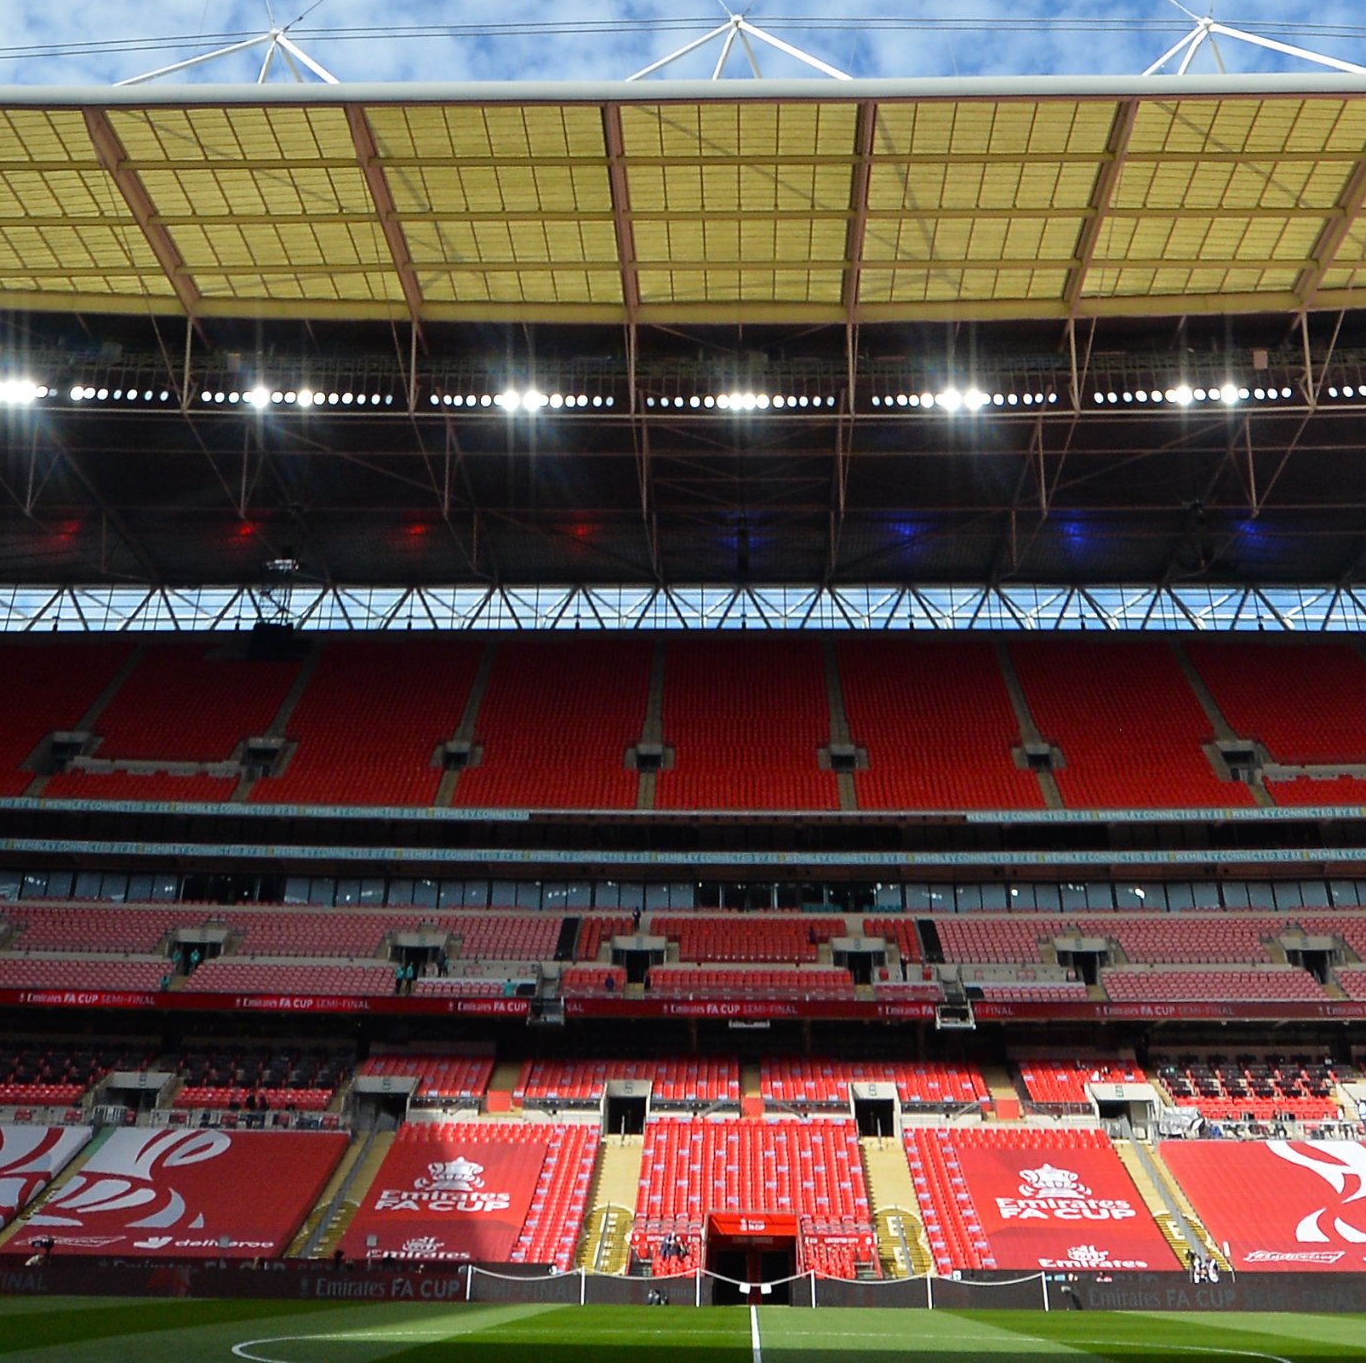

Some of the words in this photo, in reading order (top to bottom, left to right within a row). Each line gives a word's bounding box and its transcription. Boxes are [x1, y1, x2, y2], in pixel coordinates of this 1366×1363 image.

[26, 993, 61, 1003] Emirates
[63, 993, 75, 1003] FA
[77, 994, 98, 1004] CUP
[242, 997, 277, 1007] Emirates
[279, 998, 291, 1008] FA
[293, 999, 313, 1008] CUP
[457, 1001, 492, 1011] Emirates
[493, 1002, 505, 1012] FA
[507, 1002, 527, 1012] CUP
[669, 1004, 704, 1014] Emirates
[705, 1004, 718, 1014] FA
[719, 1004, 740, 1014] CUP
[921, 1006, 933, 1015] FA
[1103, 1006, 1139, 1015] Emirates
[1140, 1006, 1153, 1015] FA
[1155, 1006, 1175, 1015] CUP
[1326, 1005, 1363, 1014] Emirates
[380, 1190, 511, 1202] Emirates
[374, 1200, 421, 1212] FA
[427, 1201, 511, 1213] CUP
[995, 1197, 1131, 1209] Emirates
[998, 1208, 1049, 1220] FA
[1053, 1208, 1137, 1221] CUP
[175, 1238, 274, 1248] delieroo
[365, 1249, 472, 1260] Emirates
[1038, 1258, 1148, 1269] Emirates
[315, 1278, 385, 1297] Emirates
[390, 1279, 414, 1297] FA
[419, 1279, 461, 1297] CUP
[1088, 1287, 1161, 1308] Emirates
[1166, 1289, 1191, 1309] FA
[1195, 1289, 1237, 1309] CUP
